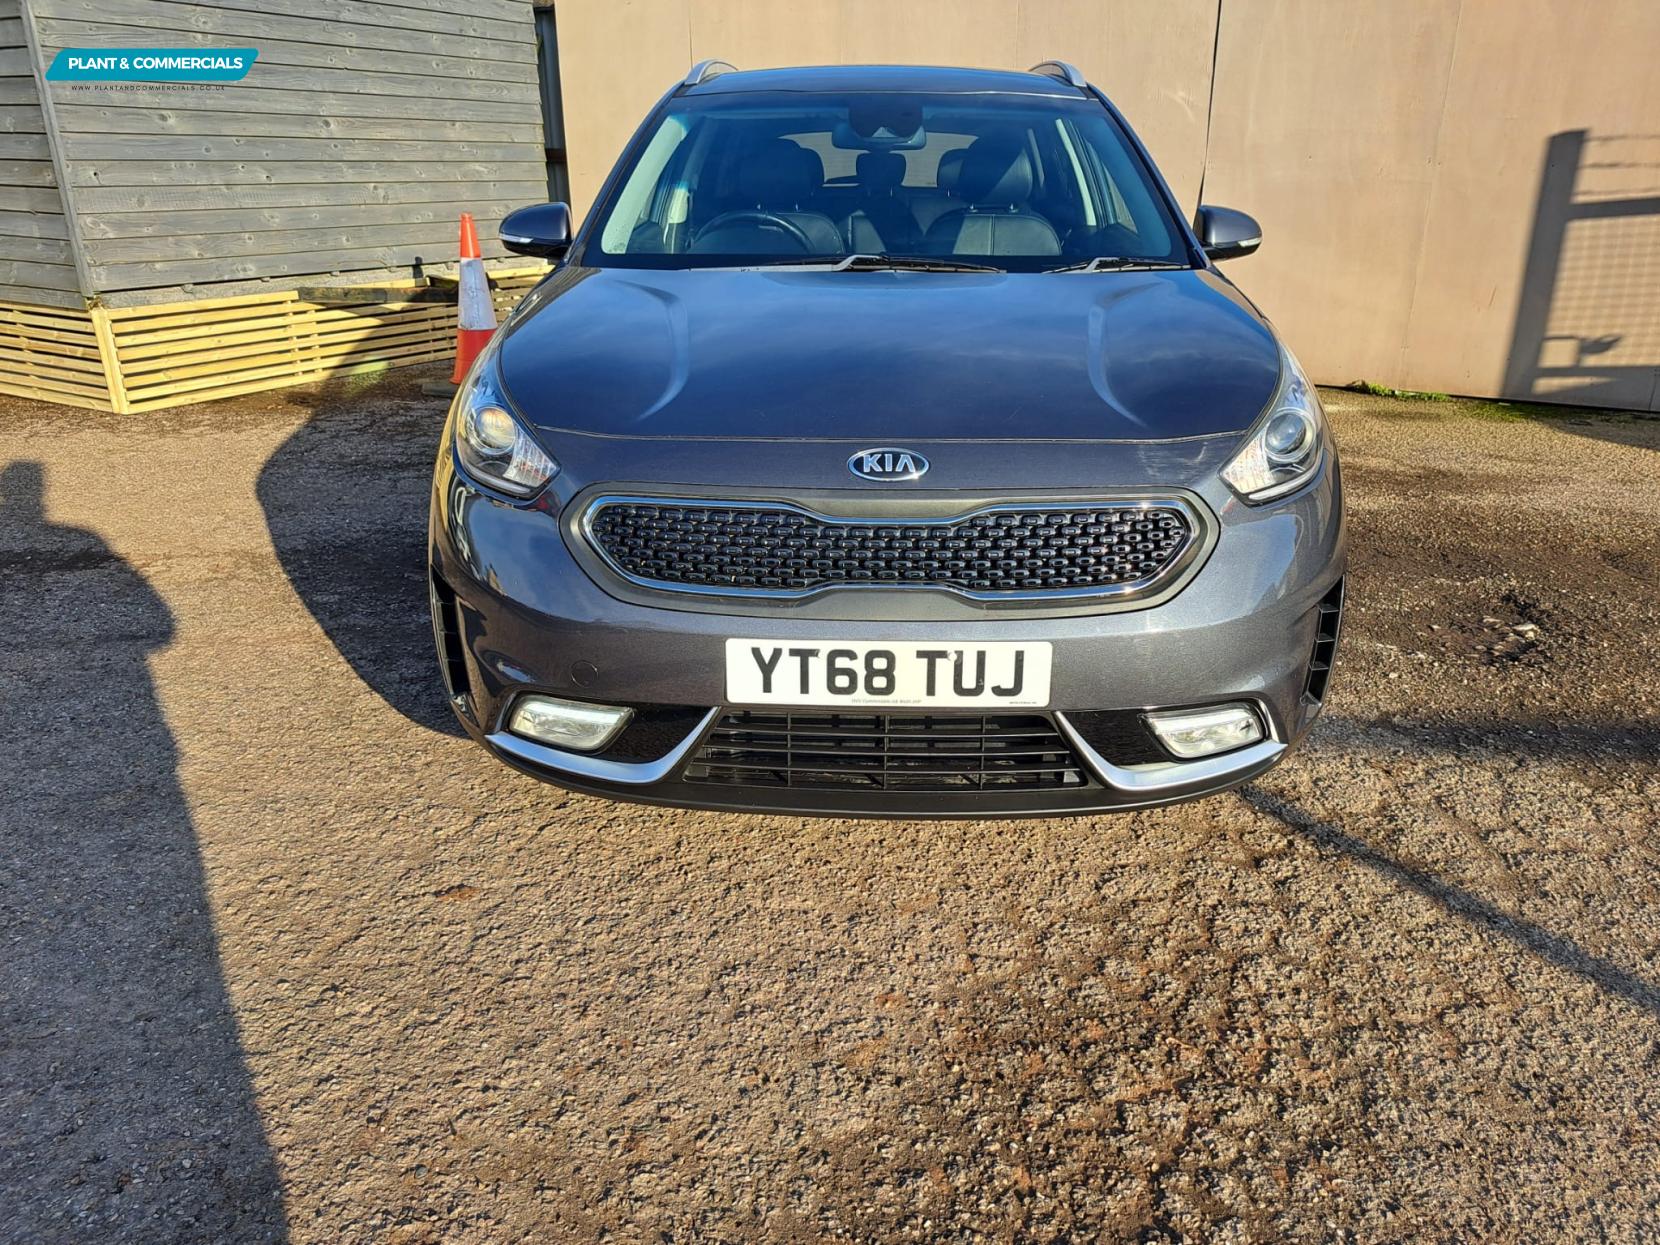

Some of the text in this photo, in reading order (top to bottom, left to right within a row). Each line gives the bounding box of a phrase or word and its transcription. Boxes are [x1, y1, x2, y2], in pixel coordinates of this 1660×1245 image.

[863, 453, 916, 473] KIA
[751, 646, 1025, 697] YT68 TUJ
